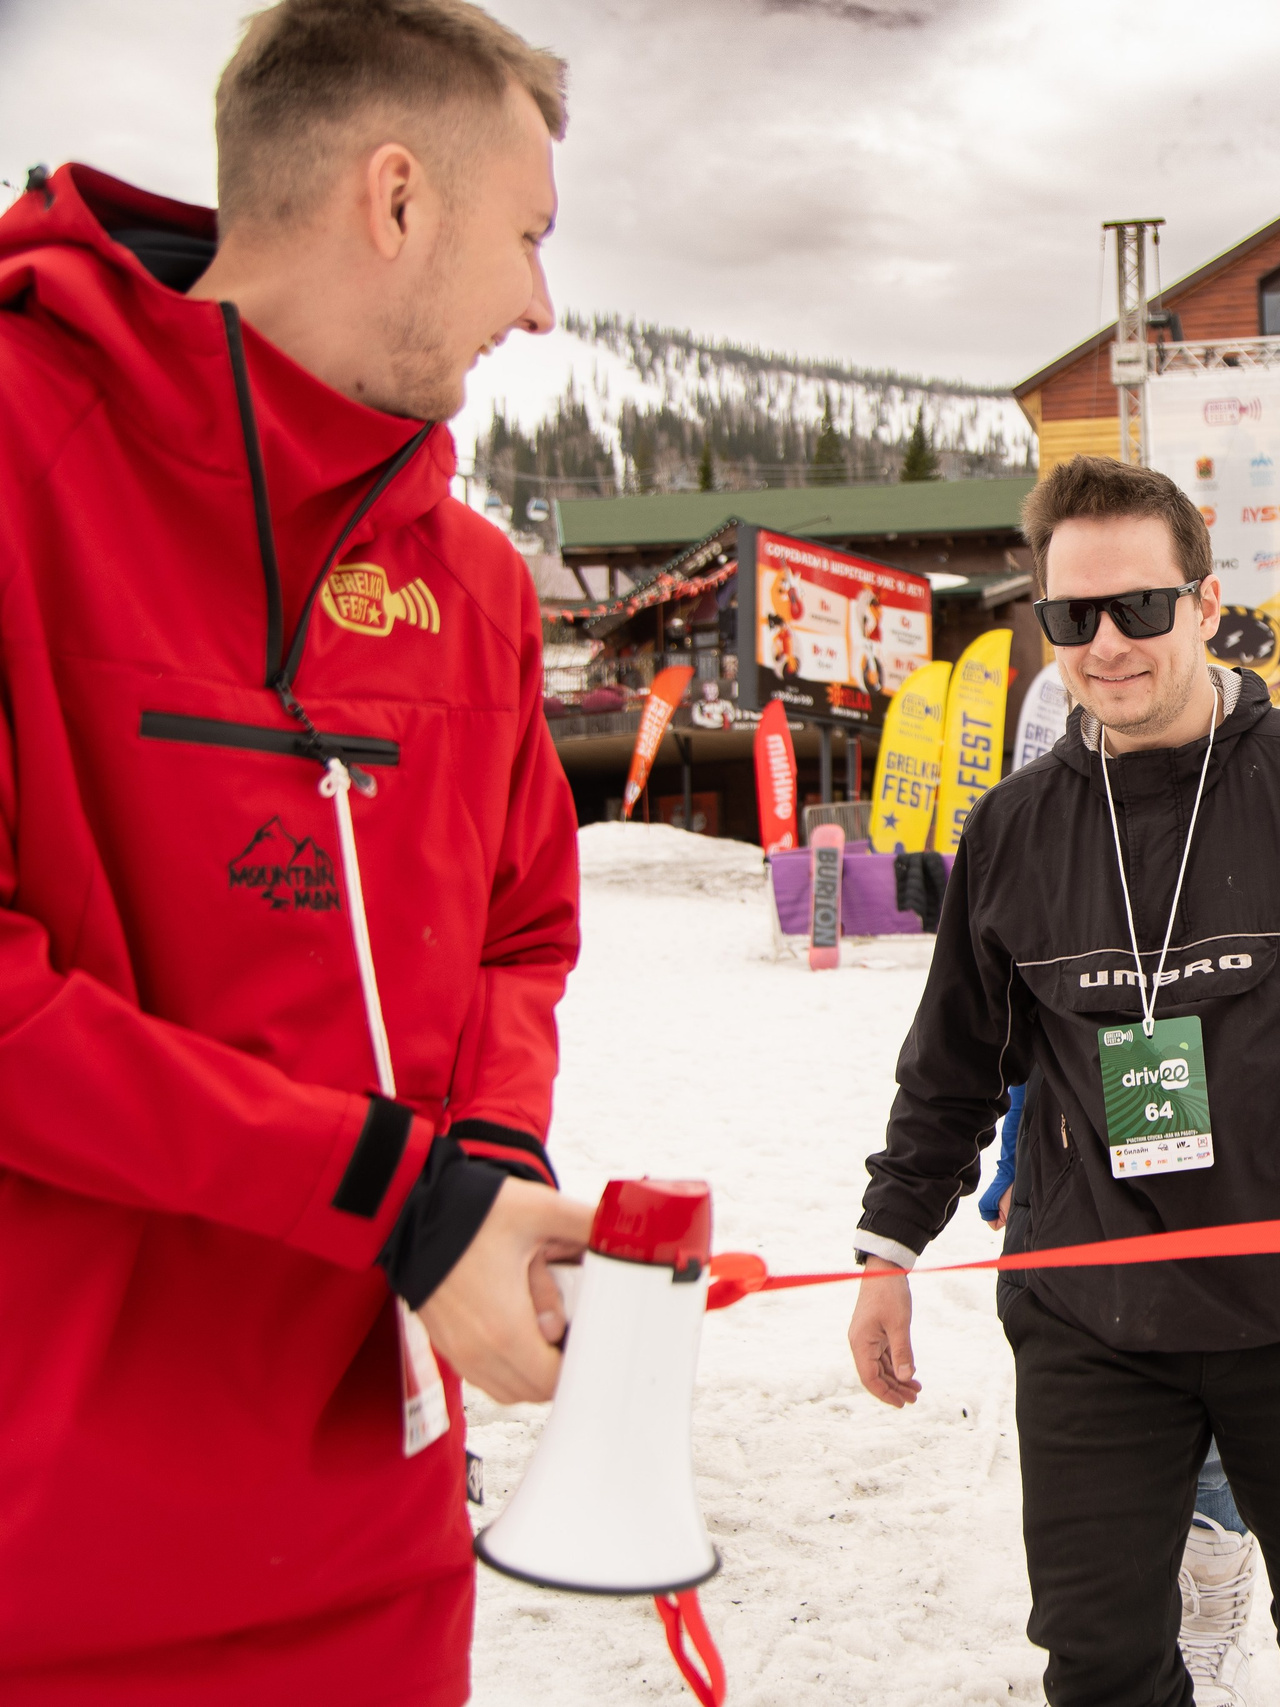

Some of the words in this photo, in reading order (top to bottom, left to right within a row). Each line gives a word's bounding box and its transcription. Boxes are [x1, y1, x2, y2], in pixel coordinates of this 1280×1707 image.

[329, 571, 382, 600] GRELKA
[337, 595, 370, 622] FEST
[958, 711, 993, 790] FEST
[766, 734, 793, 819] ФИНИШ
[886, 751, 941, 783] GRELKA
[882, 774, 936, 811] FEST
[228, 865, 336, 890] MOUNTAIN
[294, 889, 341, 911] MAN
[813, 849, 837, 946] BURTON
[1122, 1060, 1189, 1087] drivee
[1144, 1101, 1173, 1121] 64
[1123, 1147, 1149, 1155] билайн
